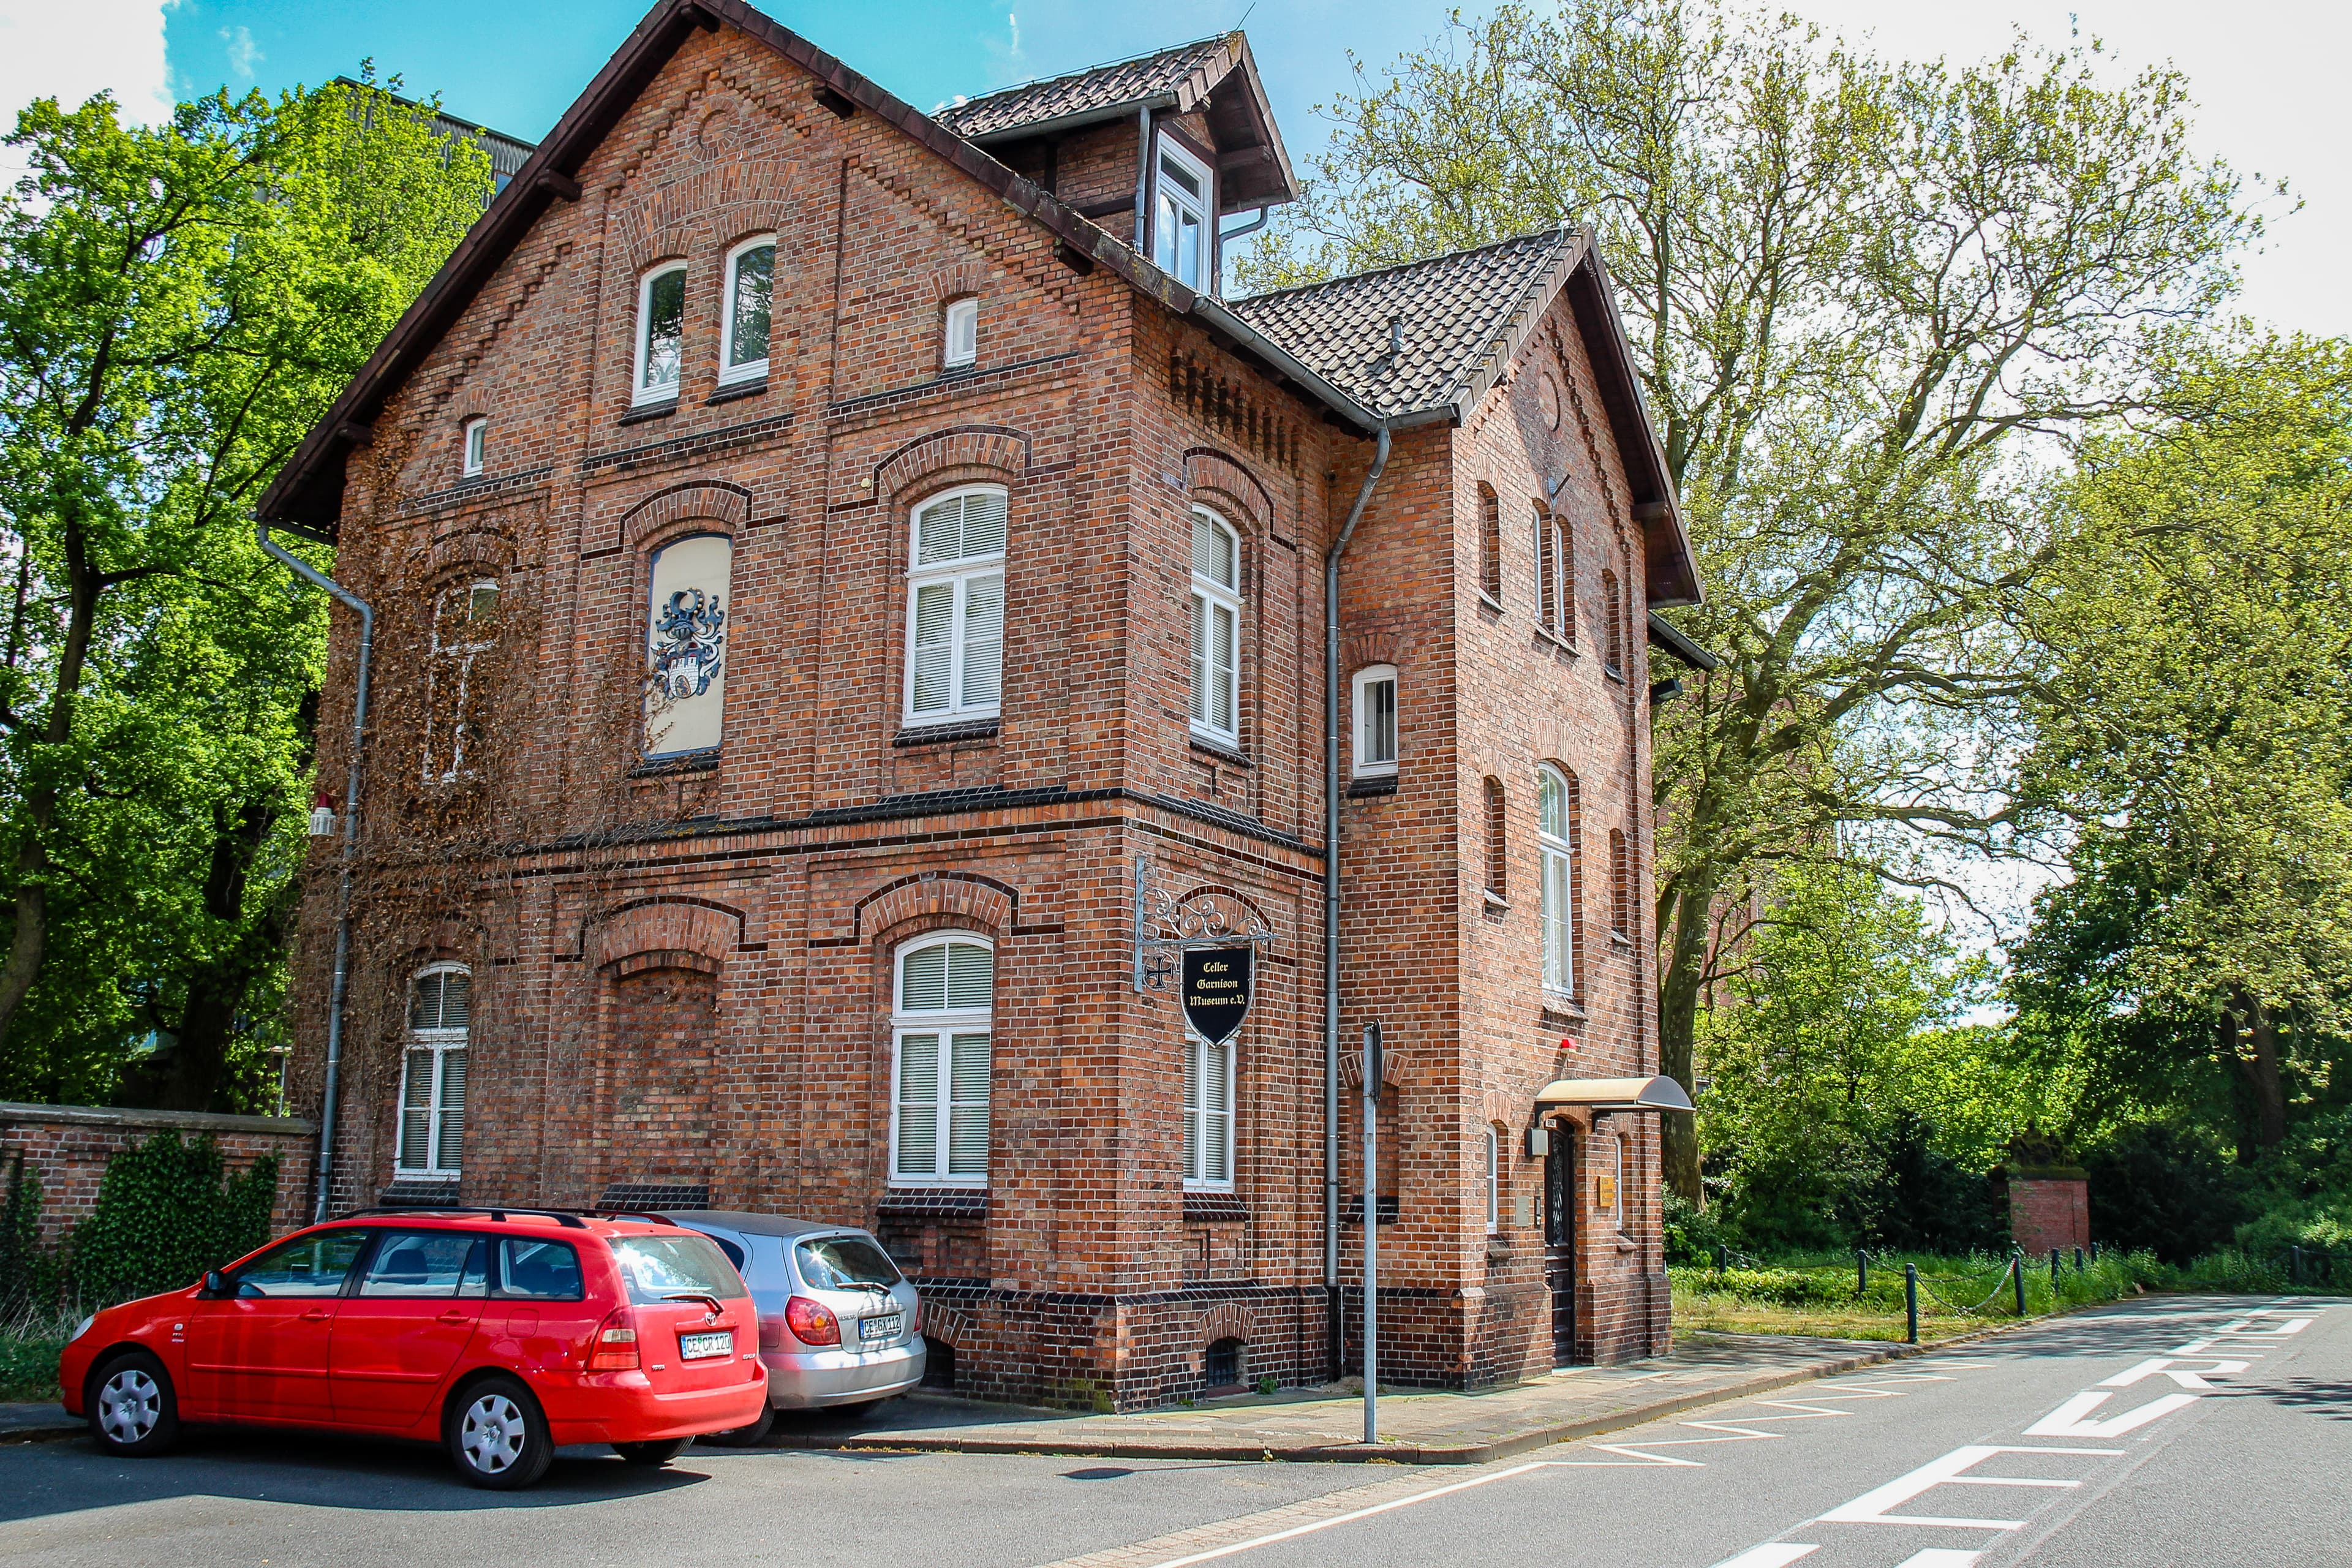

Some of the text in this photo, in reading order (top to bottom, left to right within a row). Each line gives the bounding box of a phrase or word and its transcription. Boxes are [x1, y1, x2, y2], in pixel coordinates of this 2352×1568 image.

[1203, 962, 1229, 973] Celler
[1197, 979, 1238, 989] Garnison
[1189, 994, 1245, 1006] Museum e.V.
[864, 1316, 900, 1333] CE GX 112
[687, 1335, 731, 1353] CE CR 120
